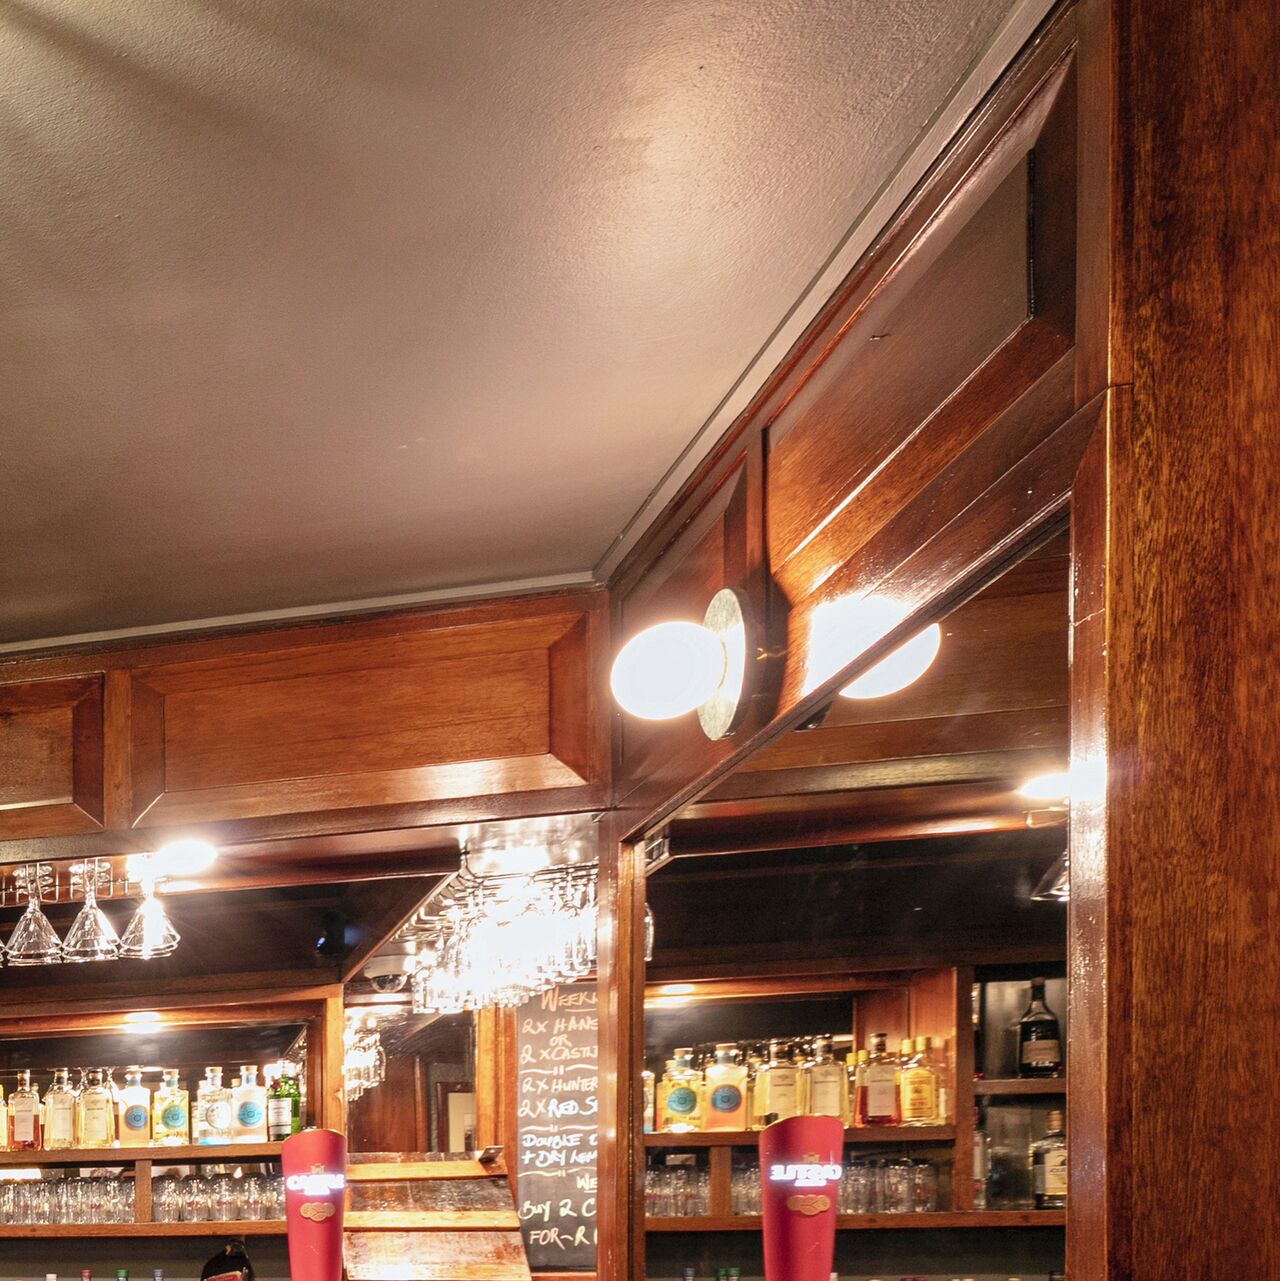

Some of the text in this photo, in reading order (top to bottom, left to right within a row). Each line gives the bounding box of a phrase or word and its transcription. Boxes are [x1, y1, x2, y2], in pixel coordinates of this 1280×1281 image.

[549, 1034, 572, 1047] OR
[547, 1098, 579, 1118] RED
[579, 1095, 598, 1115] S
[559, 1198, 578, 1217] 2
